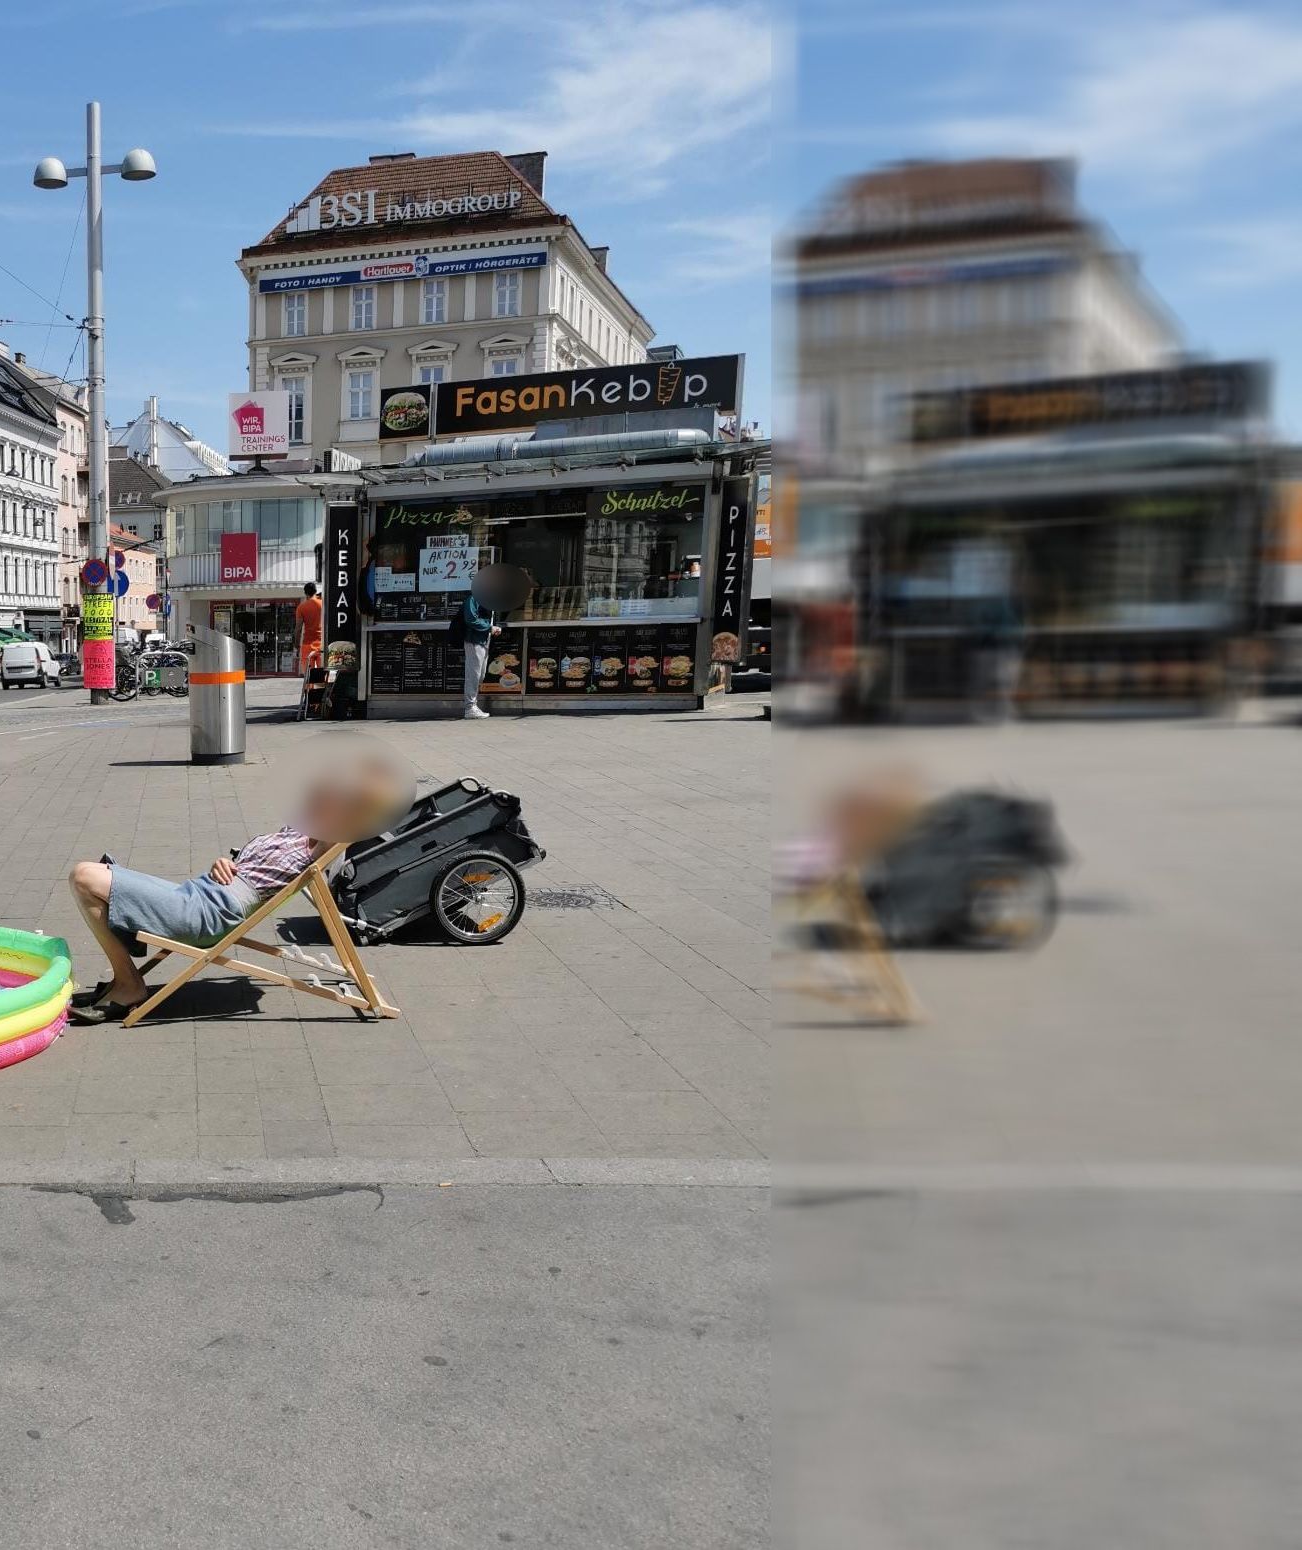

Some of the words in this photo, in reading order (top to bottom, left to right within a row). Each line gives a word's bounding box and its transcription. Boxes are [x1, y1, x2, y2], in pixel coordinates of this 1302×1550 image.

[366, 263, 412, 278] Hartlauer
[435, 262, 466, 273] OPTIK
[475, 255, 539, 269] HÖRGERÄTE
[274, 279, 300, 289] FOTO
[307, 275, 342, 286] HANDY
[242, 425, 261, 433] BIPA
[242, 435, 286, 443] TRAININGS
[601, 489, 696, 515] Schnitzel
[384, 505, 446, 529] Pizza
[428, 550, 468, 564] AKTION
[722, 505, 739, 617] PIZZA
[224, 566, 253, 578] BIPA
[337, 528, 349, 628] KEBAP
[145, 670, 157, 685] P
